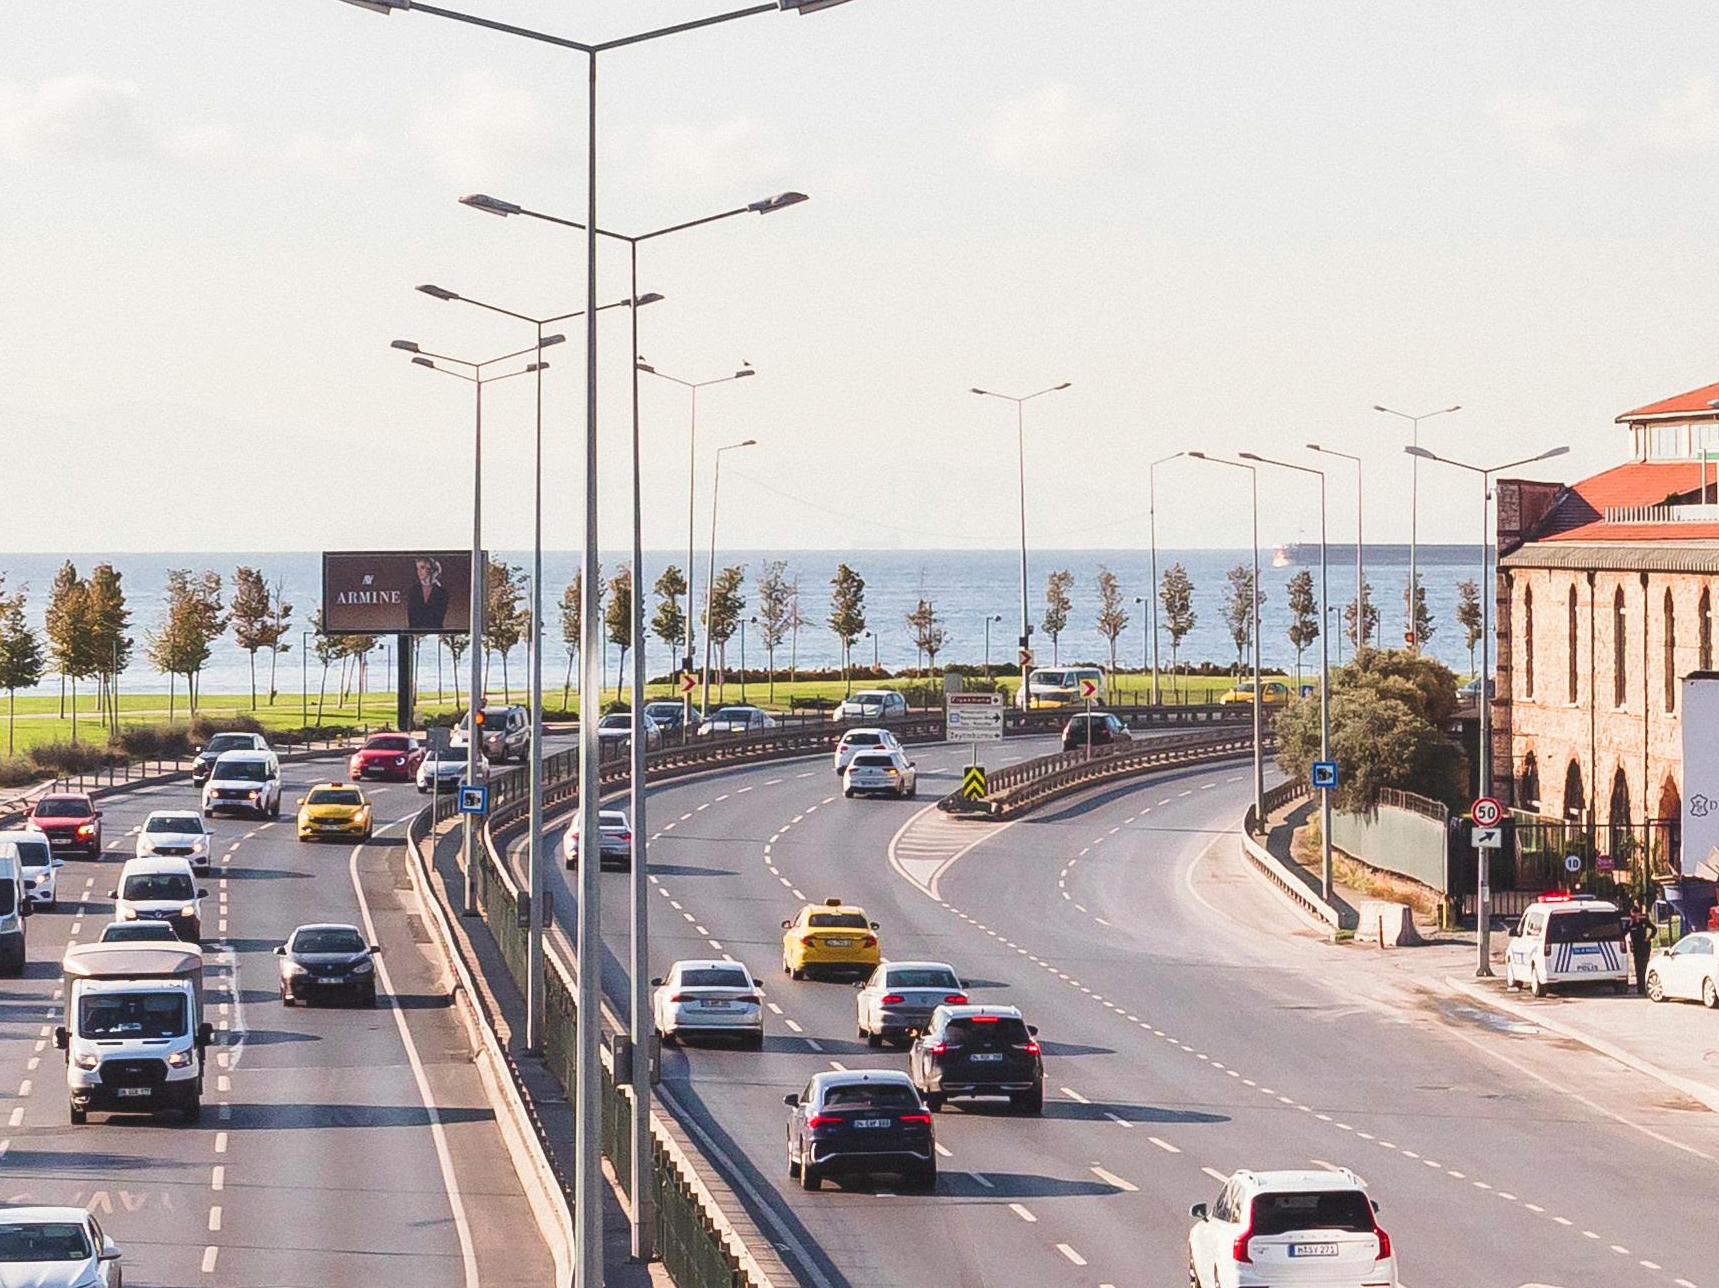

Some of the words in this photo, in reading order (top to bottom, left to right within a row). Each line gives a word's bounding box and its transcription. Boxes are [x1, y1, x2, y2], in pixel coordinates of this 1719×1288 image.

[337, 590, 401, 604] ARMINE
[1478, 805, 1495, 819] 50
[1567, 859, 1579, 868] 10
